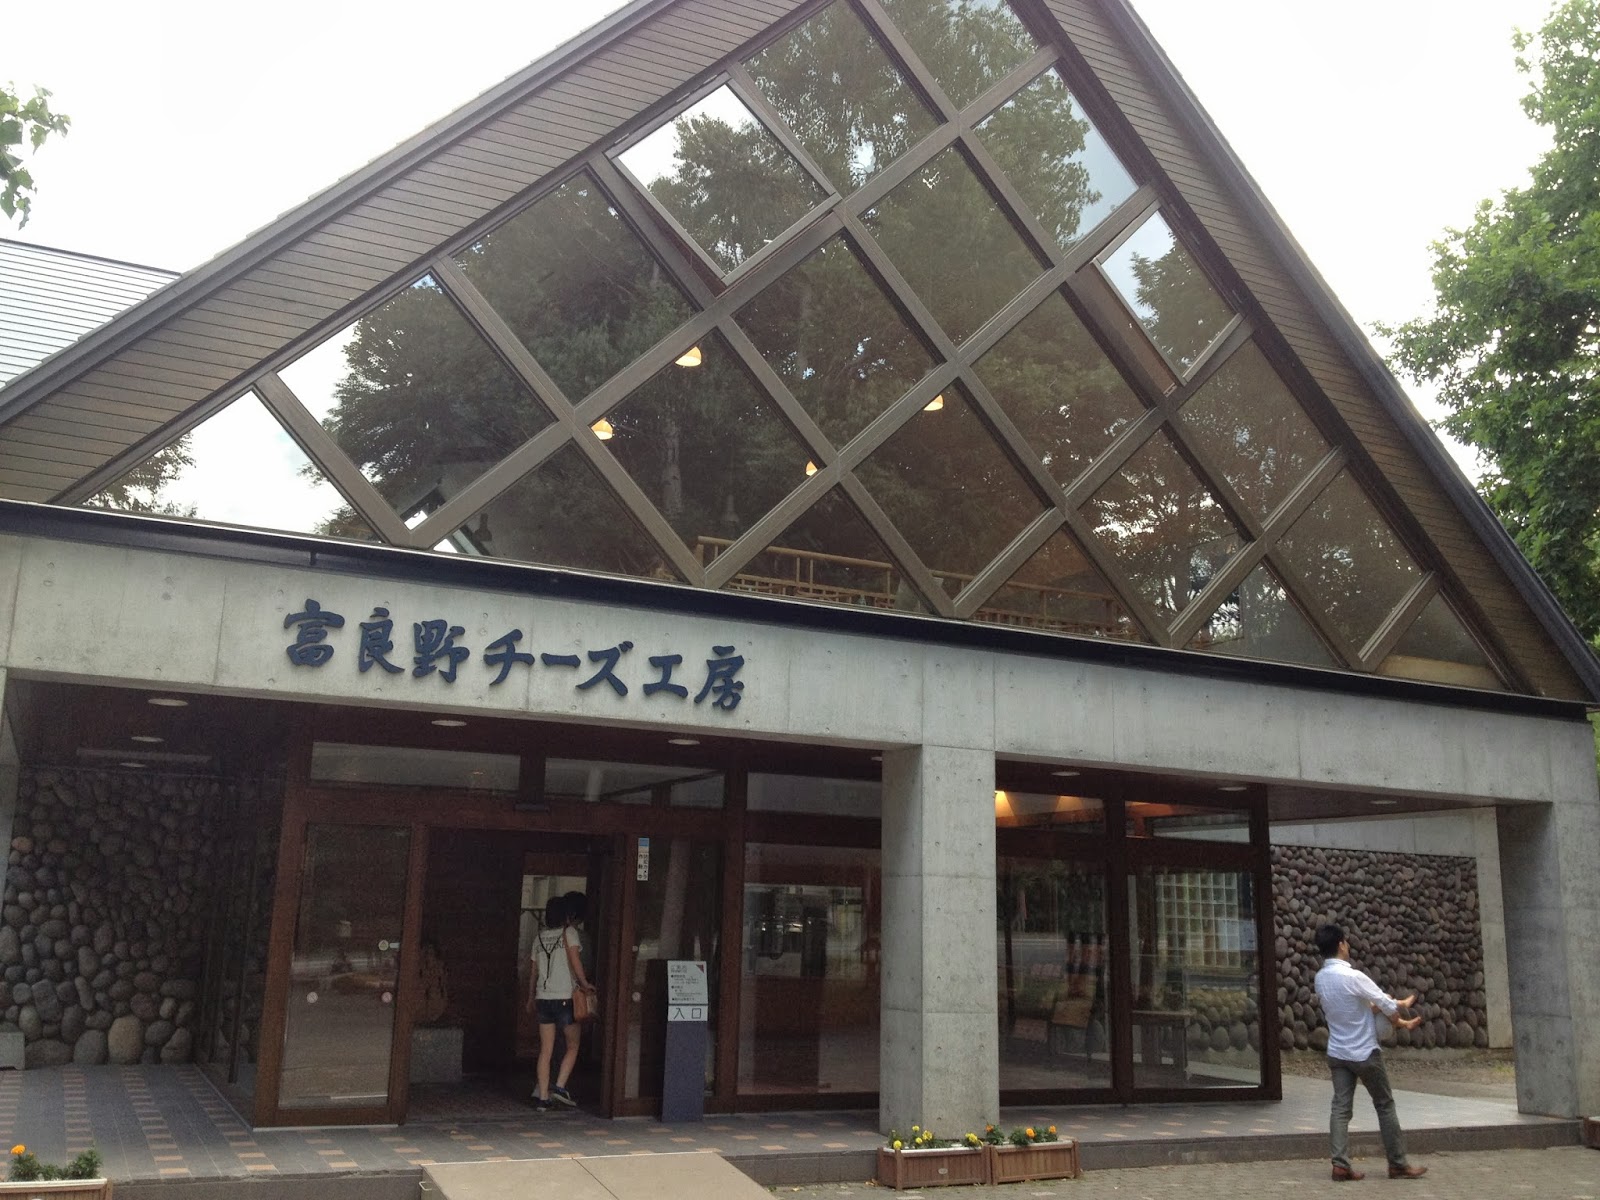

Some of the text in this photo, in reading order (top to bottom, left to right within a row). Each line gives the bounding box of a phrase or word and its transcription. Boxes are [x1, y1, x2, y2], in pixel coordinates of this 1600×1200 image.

[284, 599, 744, 710] 富良野チーズ工房
[673, 1008, 702, 1020] 入口
